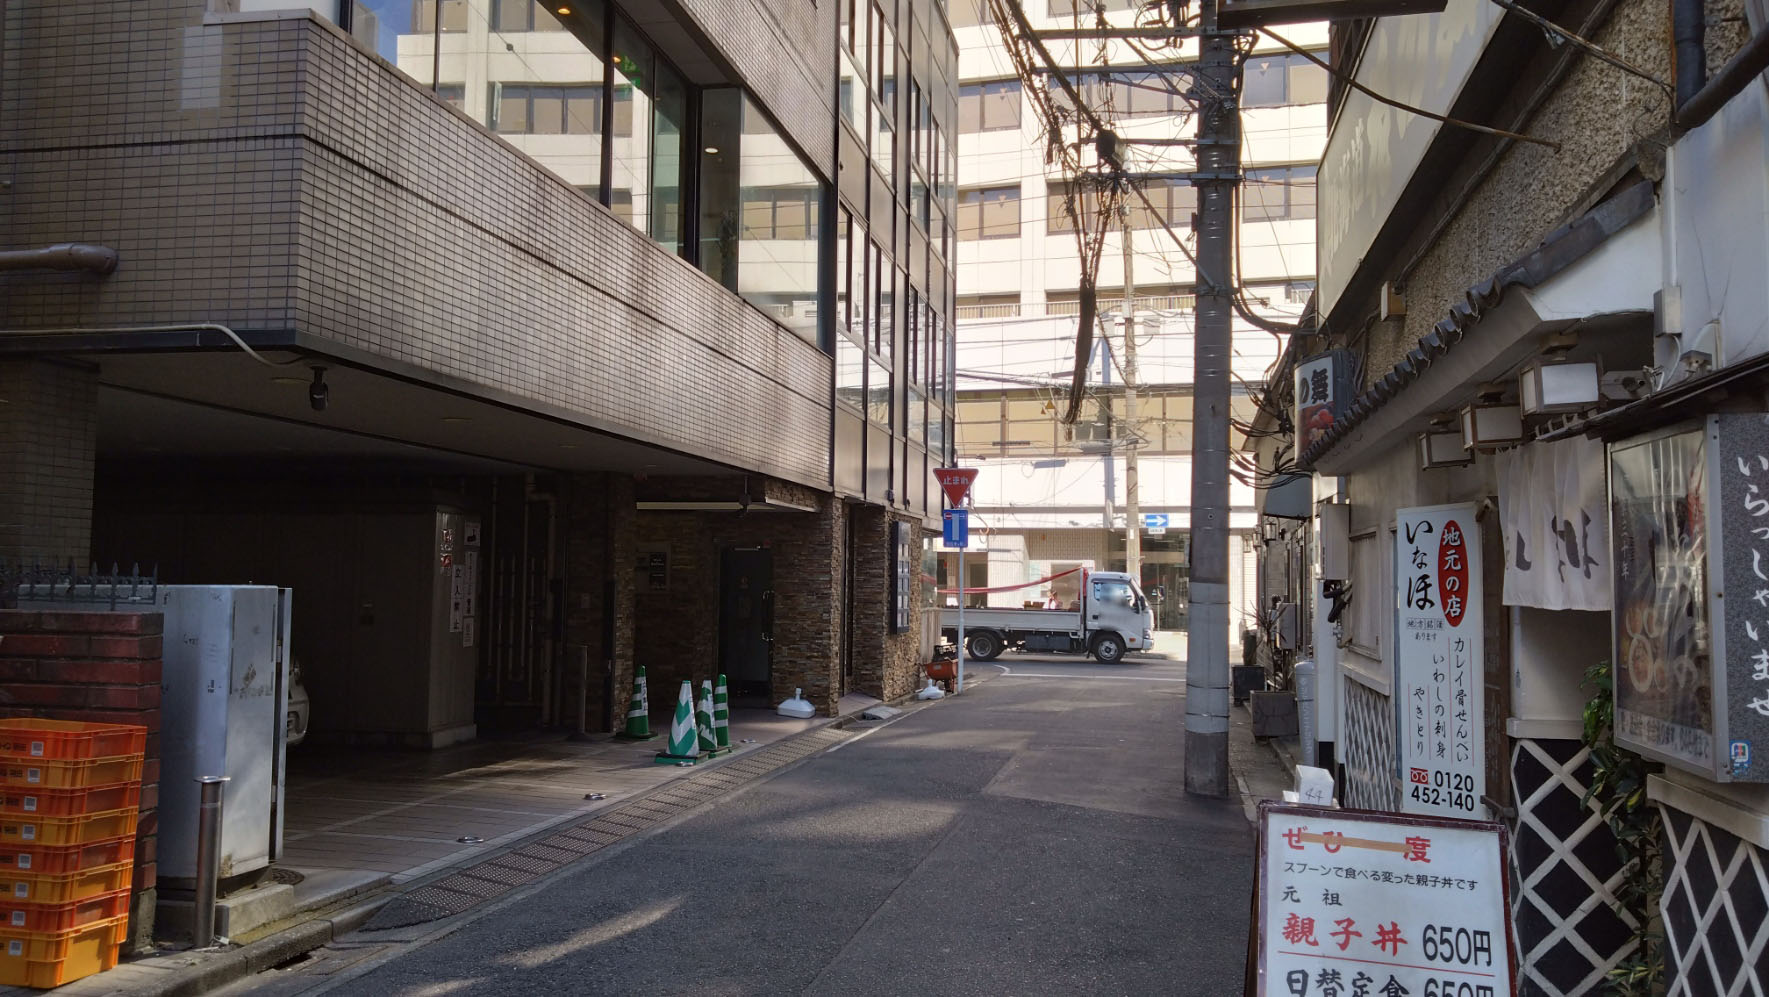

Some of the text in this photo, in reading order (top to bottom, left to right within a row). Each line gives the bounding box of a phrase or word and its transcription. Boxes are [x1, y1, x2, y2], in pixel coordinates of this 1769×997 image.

[943, 475, 969, 486] 止まれ
[1405, 520, 1436, 610] いなほ
[1442, 526, 1462, 618] 地元の店
[1415, 632, 1437, 641] あります
[1413, 687, 1425, 756] やきとり
[1433, 654, 1446, 759] いわしの刺身
[1454, 637, 1469, 762] カレイ骨せんべい
[1411, 785, 1474, 812] 452-140
[1434, 770, 1474, 793] 0120
[1281, 886, 1343, 907] 元祖
[1281, 912, 1408, 957] 親子丼
[1422, 923, 1493, 968] 650円
